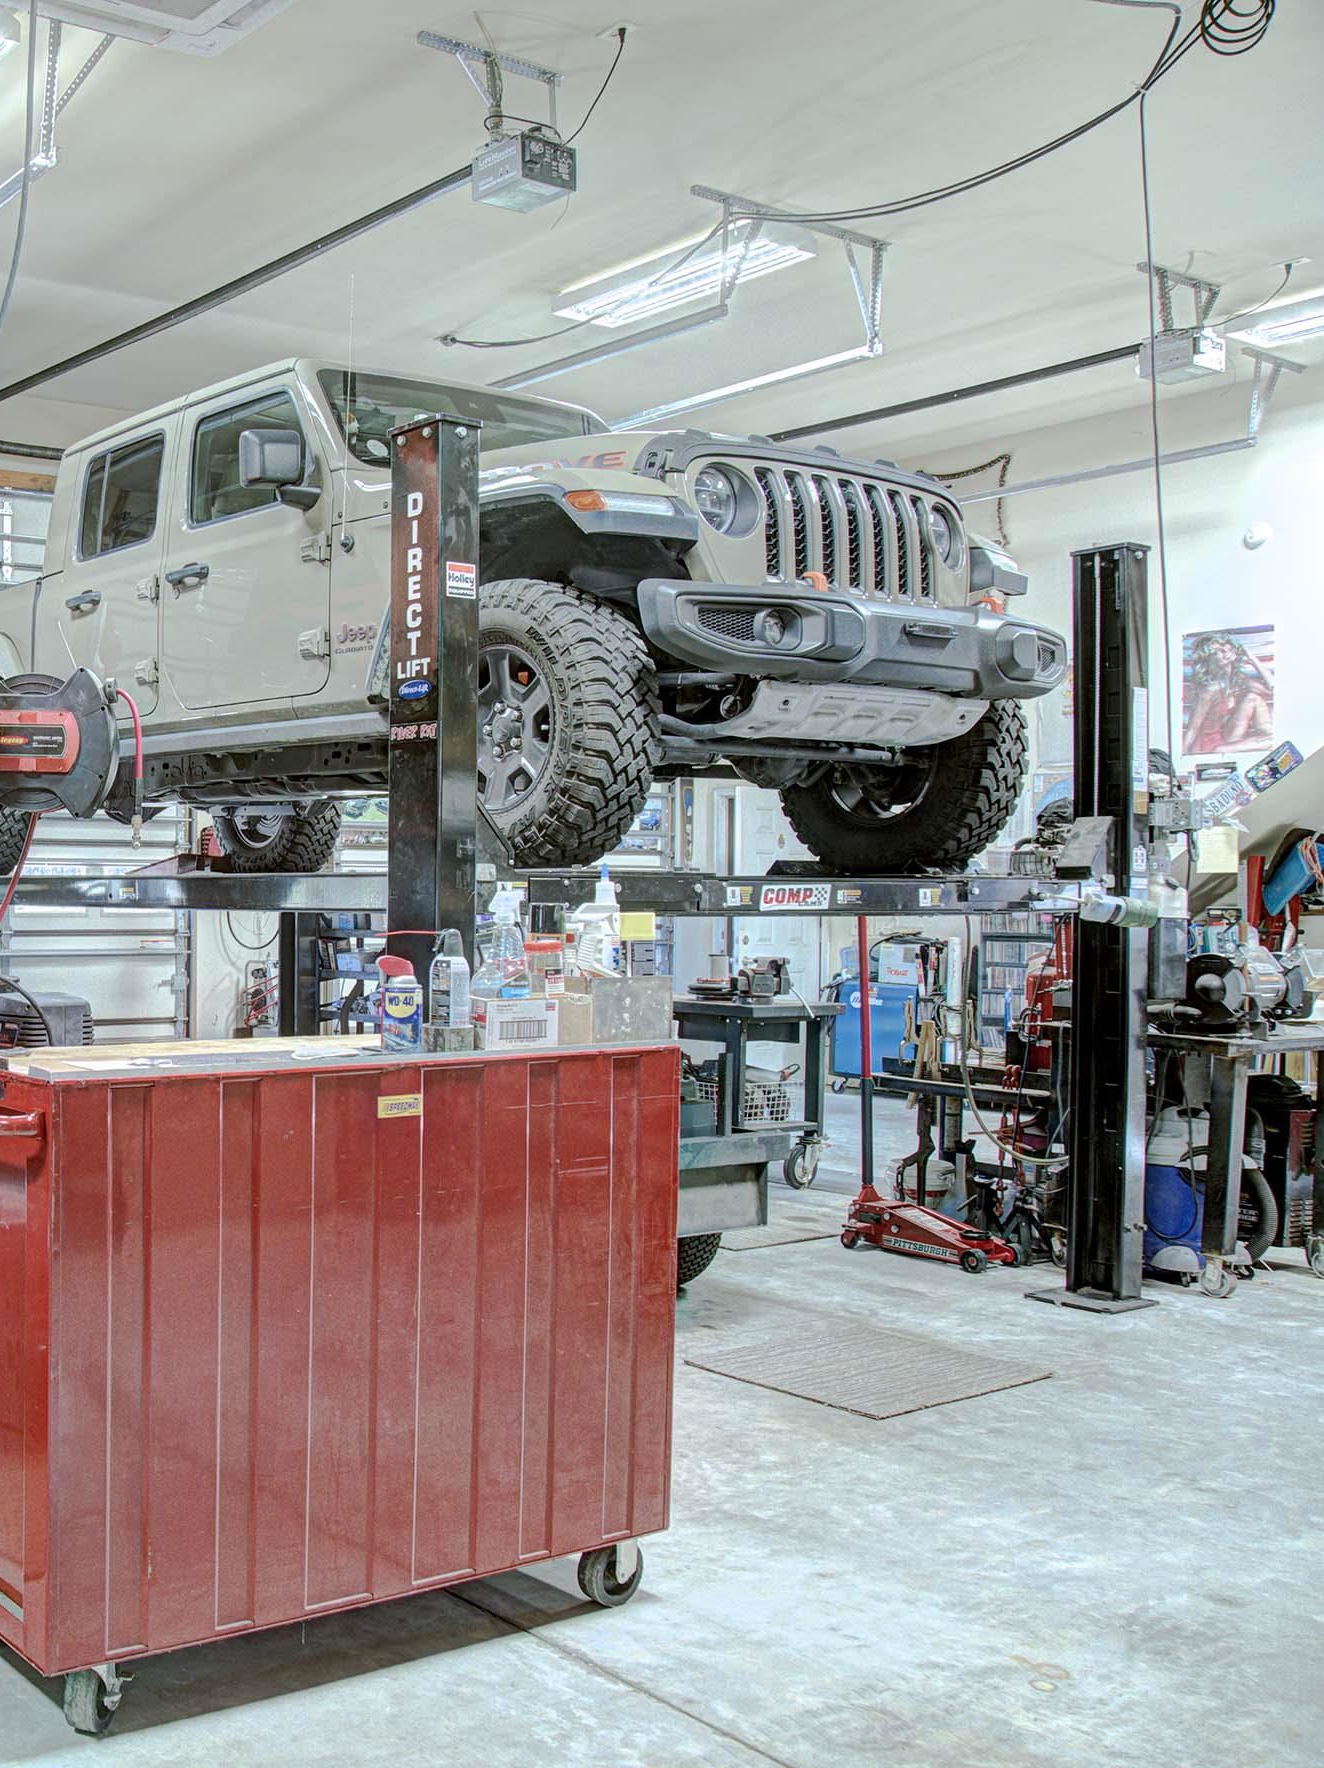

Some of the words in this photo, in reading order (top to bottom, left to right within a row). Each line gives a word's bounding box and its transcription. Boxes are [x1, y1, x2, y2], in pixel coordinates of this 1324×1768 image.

[406, 491, 423, 656] DIRECT
[448, 572, 475, 587] Holley
[338, 623, 376, 644] Jeep
[396, 657, 431, 680] LIFT
[763, 887, 815, 905] COMP
[388, 995, 414, 1007] WD-40
[892, 1239, 949, 1257] PITTSBURGH
